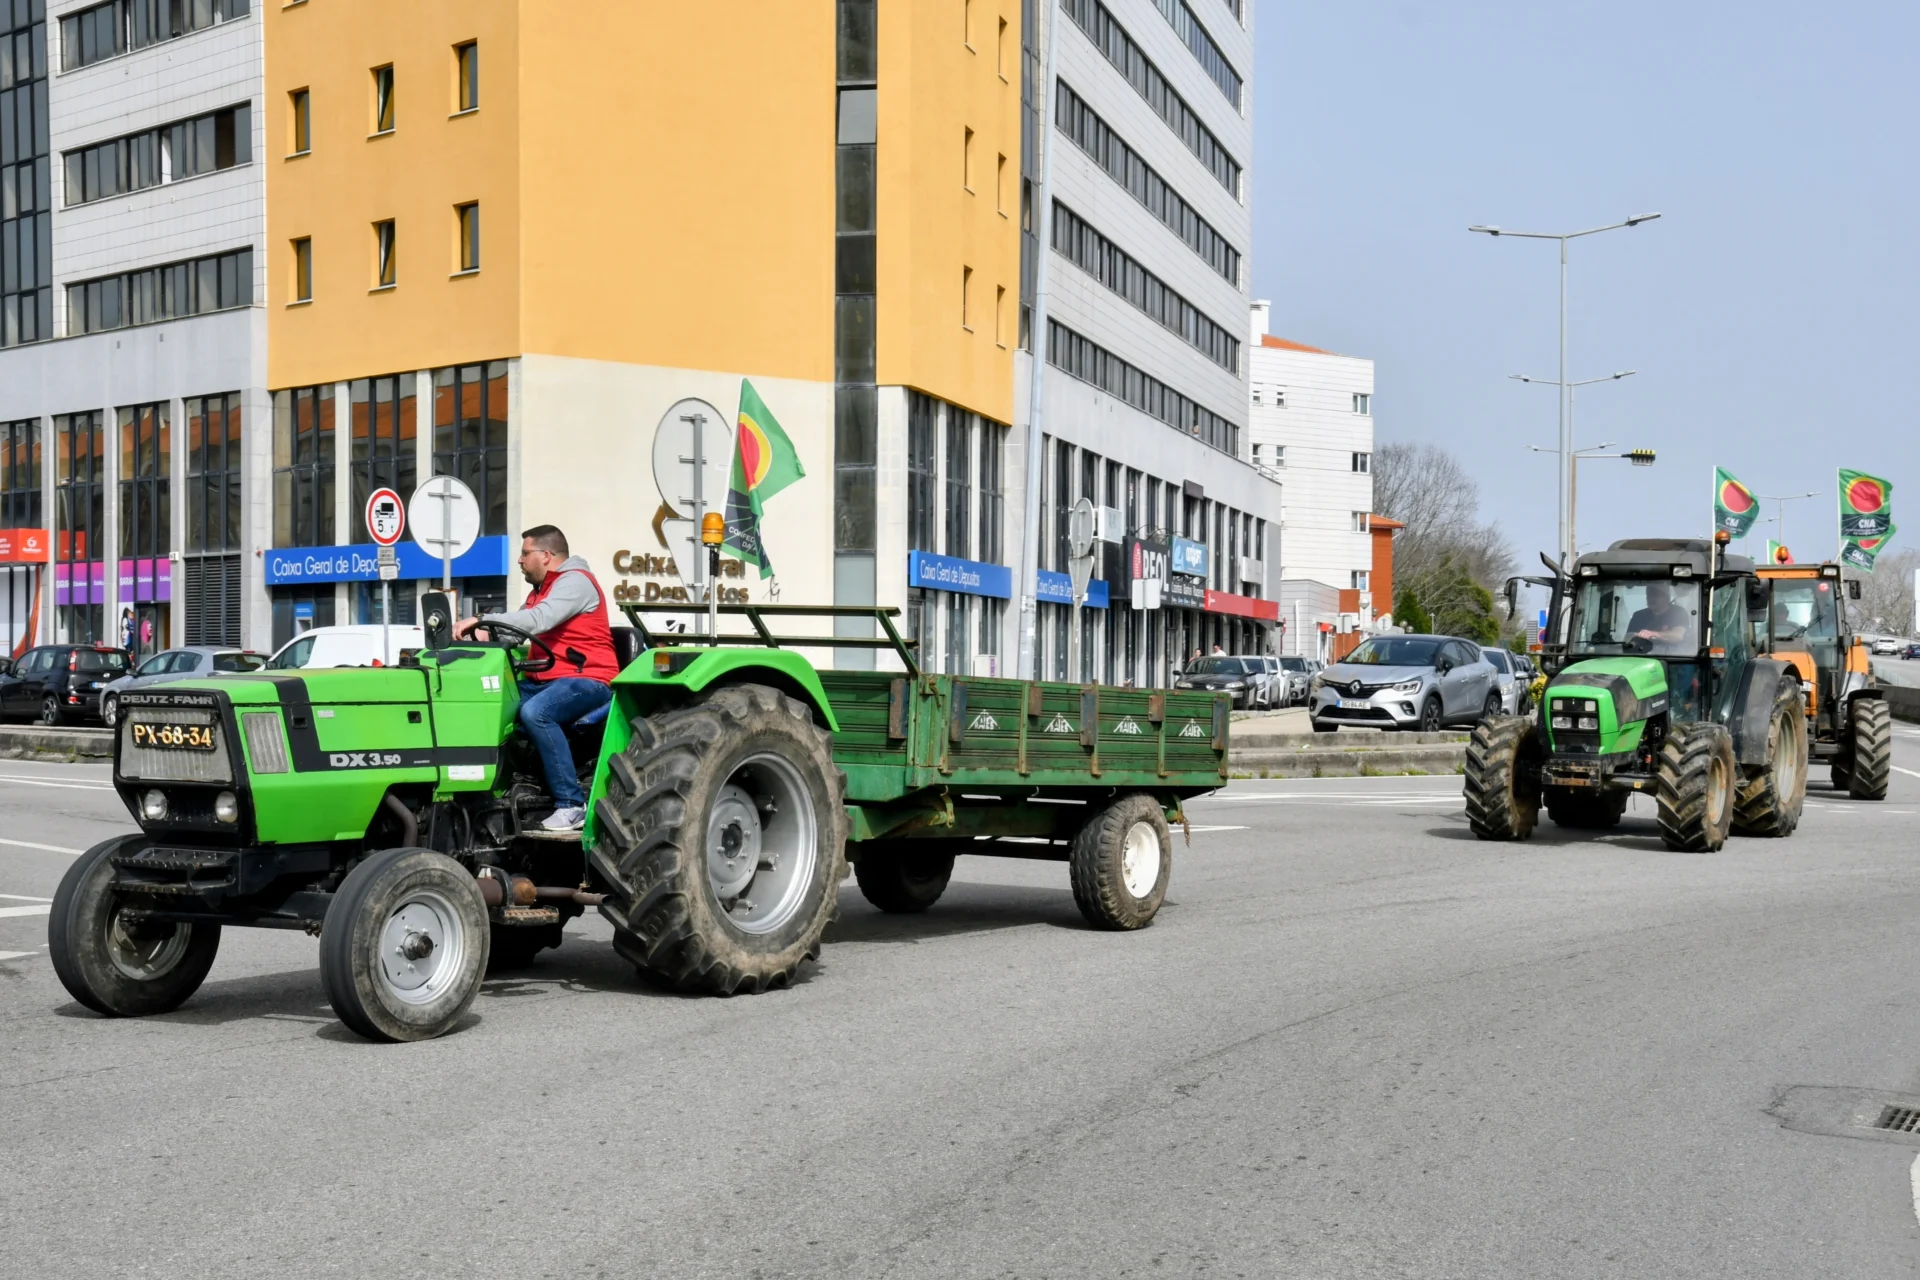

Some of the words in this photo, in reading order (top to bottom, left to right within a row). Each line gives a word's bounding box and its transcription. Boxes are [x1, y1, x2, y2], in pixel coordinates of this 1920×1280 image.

[377, 519, 384, 533] 5
[1858, 518, 1876, 529] CNA
[272, 556, 302, 577] Caixa
[305, 555, 333, 576] Geral
[335, 556, 349, 574] de
[352, 553, 401, 577] Depos
[612, 549, 679, 575] Caixa
[920, 559, 936, 580] Caixa
[936, 562, 950, 582] Geral
[951, 565, 958, 584] de
[613, 579, 641, 601] de
[645, 581, 749, 603] Deptos
[120, 694, 213, 705] DEUTZ-FAHR
[134, 724, 212, 746] PX-68-34
[329, 753, 367, 767] DX
[368, 752, 401, 766] 3.50
